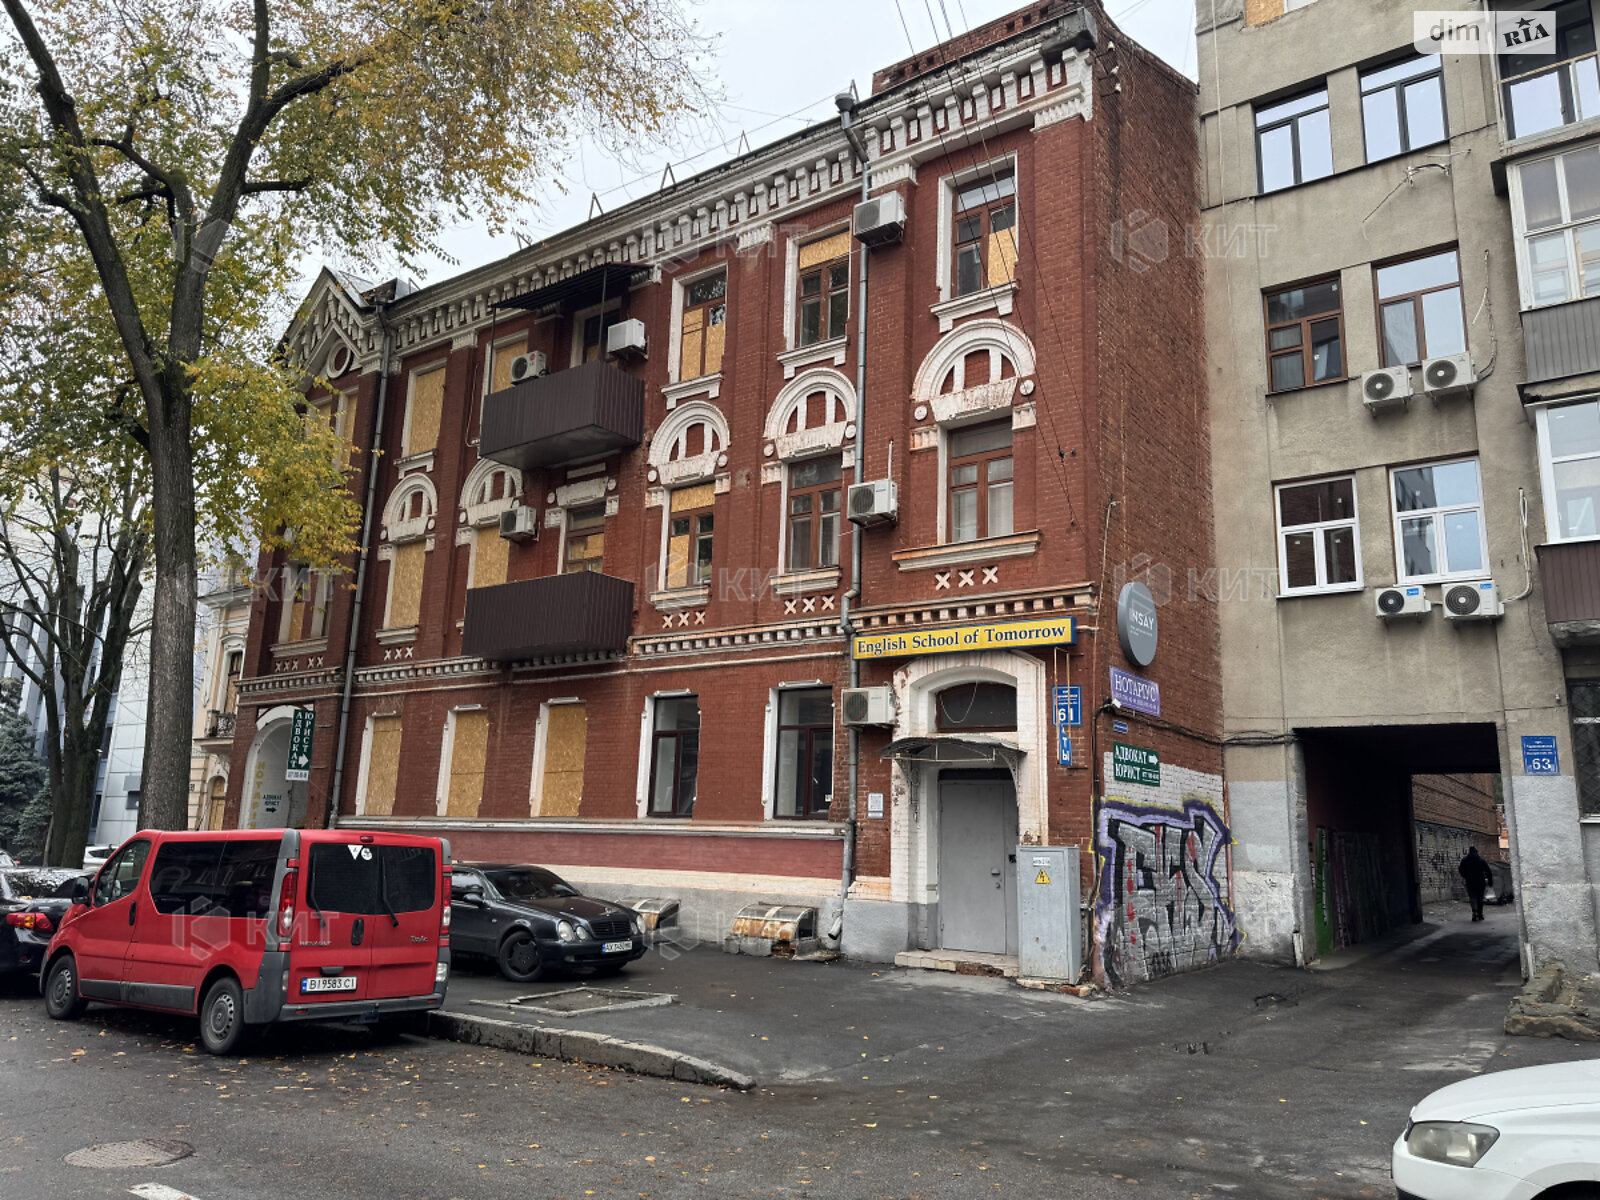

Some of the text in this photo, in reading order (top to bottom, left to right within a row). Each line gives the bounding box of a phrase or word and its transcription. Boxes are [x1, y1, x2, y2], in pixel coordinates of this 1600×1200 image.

[857, 625, 1066, 655] English School of Tomorrow
[1059, 707, 1074, 721] 61
[1532, 757, 1552, 770] 63
